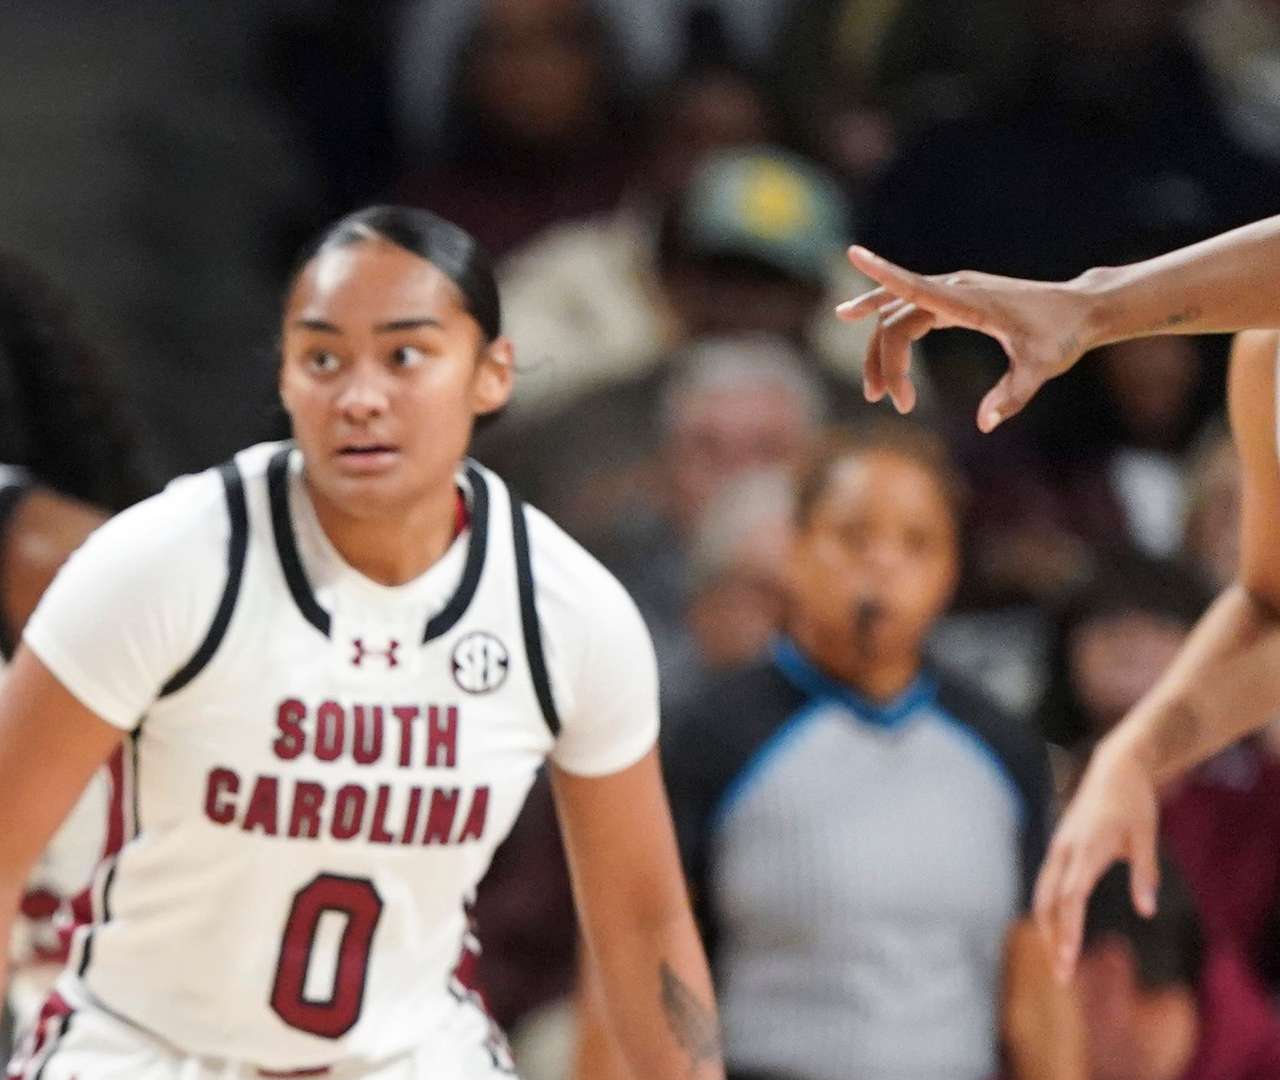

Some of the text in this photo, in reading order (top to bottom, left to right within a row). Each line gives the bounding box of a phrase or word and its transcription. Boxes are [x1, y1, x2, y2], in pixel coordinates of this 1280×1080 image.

[273, 698, 459, 768] SOUTH
[204, 766, 491, 846] CAROLINA
[269, 871, 384, 1039] 0
